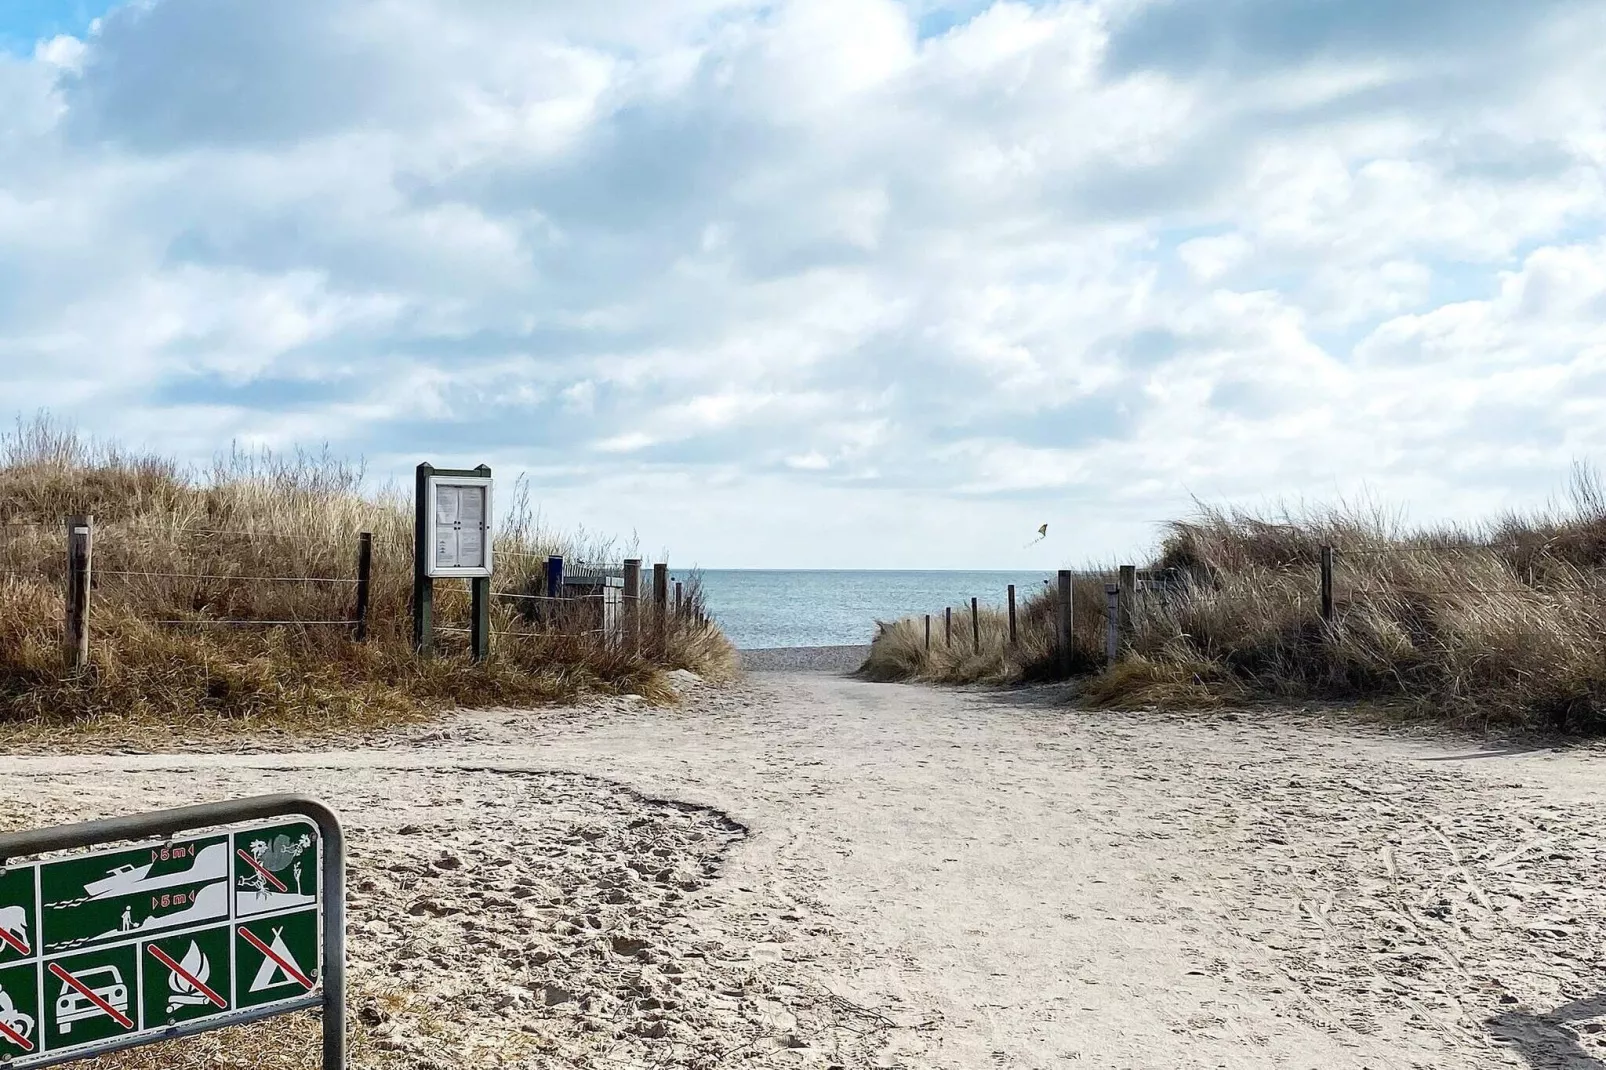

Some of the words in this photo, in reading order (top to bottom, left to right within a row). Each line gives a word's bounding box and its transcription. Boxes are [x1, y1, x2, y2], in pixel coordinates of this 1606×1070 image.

[161, 849, 169, 861] 5
[173, 848, 186, 858] m
[161, 894, 170, 907] 5
[173, 894, 186, 905] m
